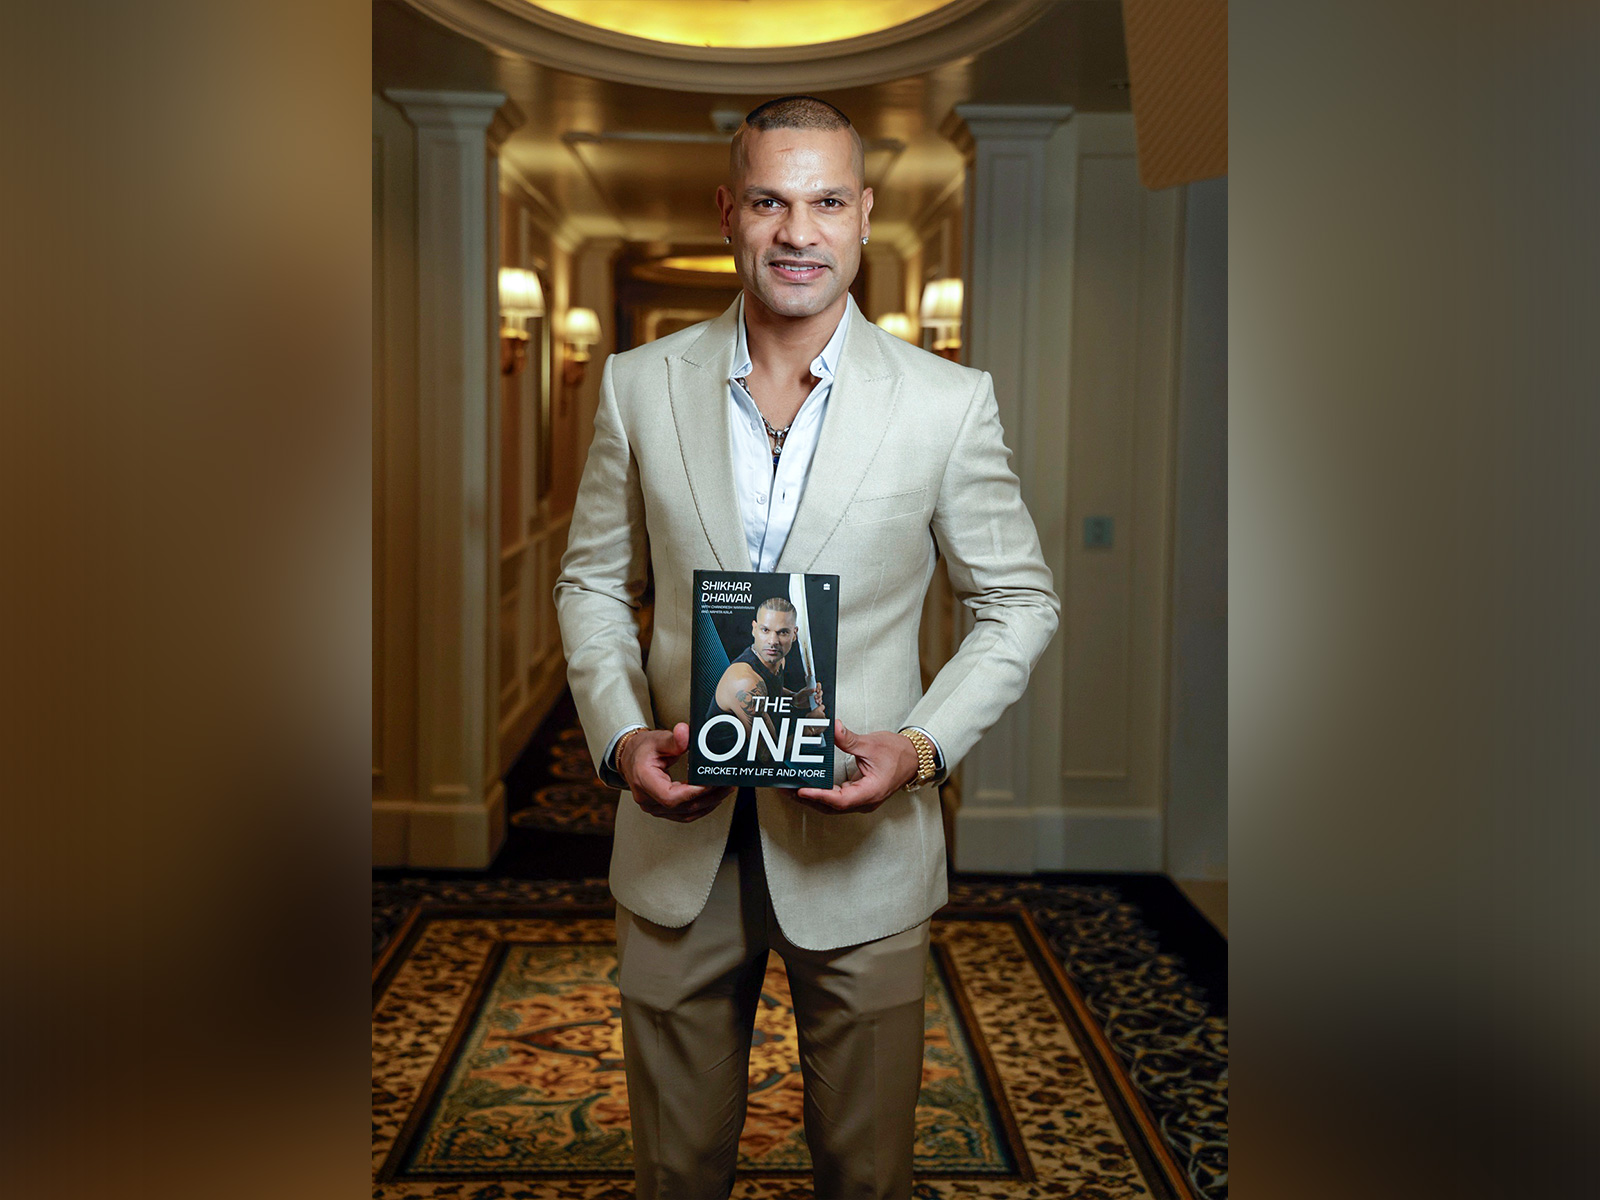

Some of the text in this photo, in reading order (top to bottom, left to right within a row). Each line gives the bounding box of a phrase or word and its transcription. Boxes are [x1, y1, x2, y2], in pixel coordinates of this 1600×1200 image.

[701, 580, 752, 591] SHIKHAR
[701, 592, 752, 603] DHAWAN
[752, 696, 793, 713] THE
[697, 714, 831, 763] ONE
[697, 766, 826, 778] CRICKET, MY LIFE AND MORE
